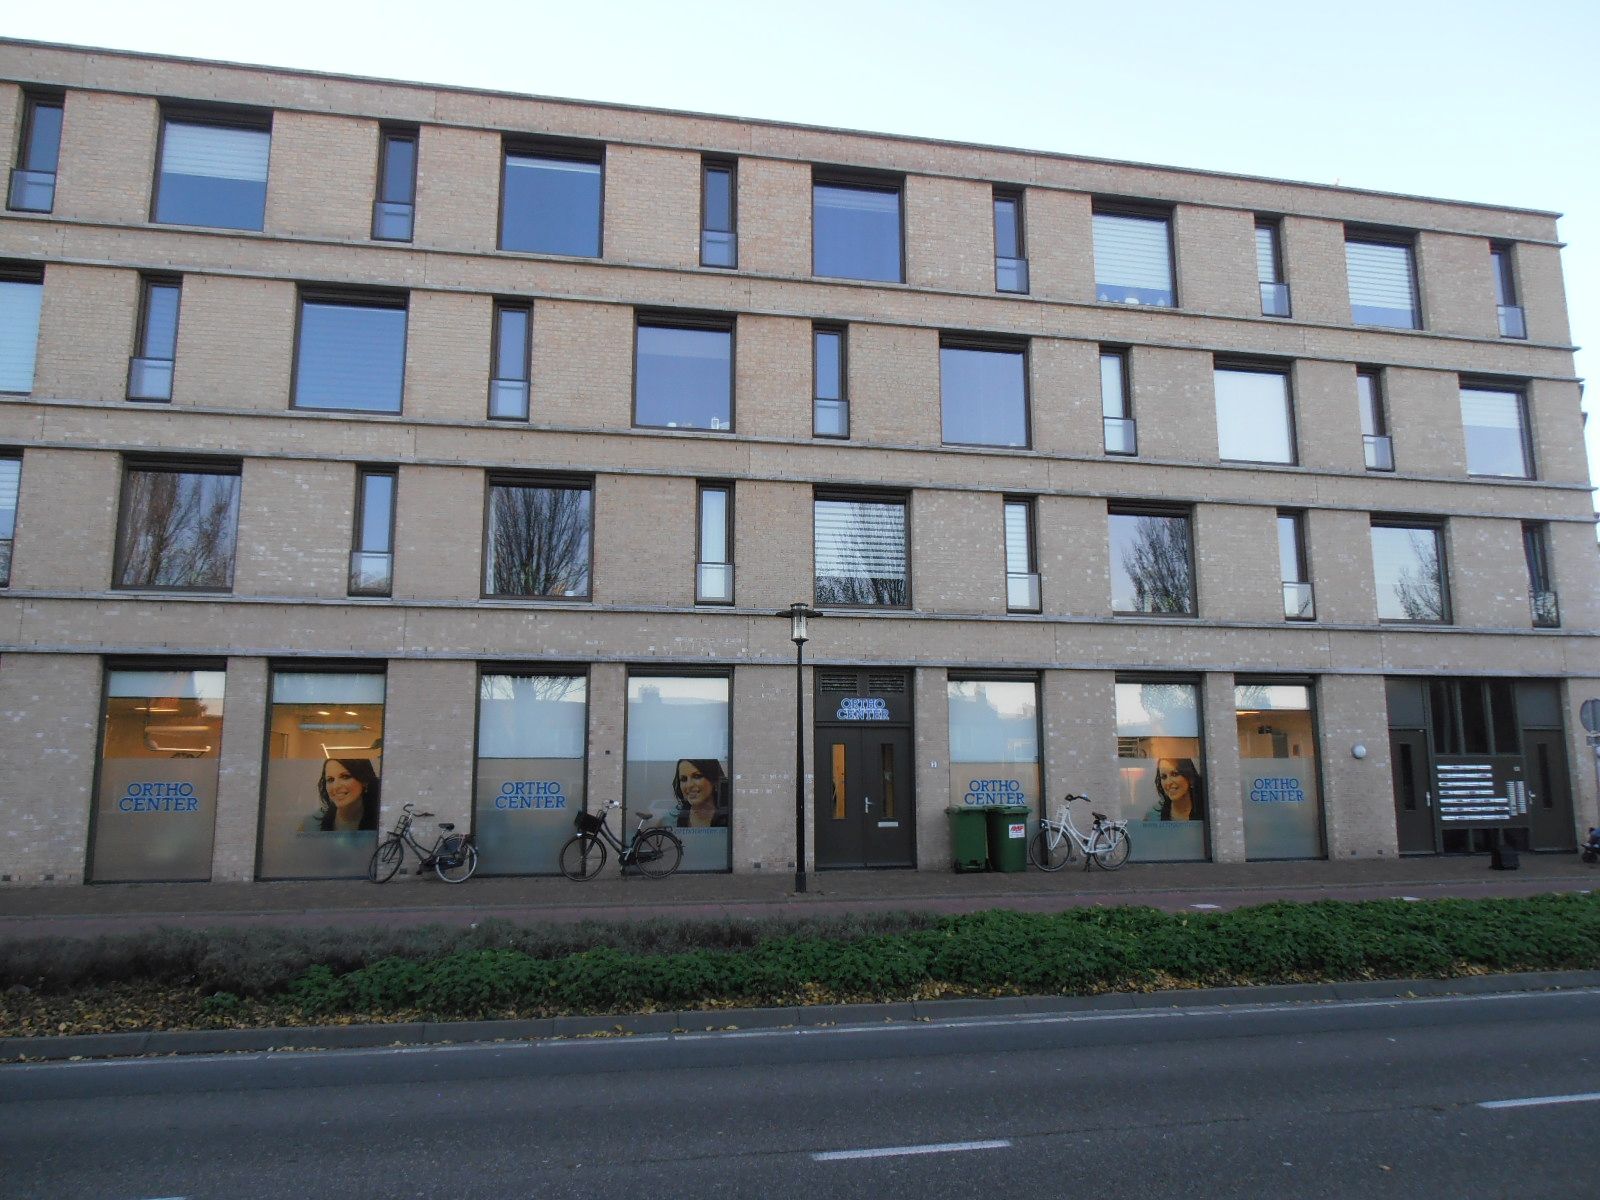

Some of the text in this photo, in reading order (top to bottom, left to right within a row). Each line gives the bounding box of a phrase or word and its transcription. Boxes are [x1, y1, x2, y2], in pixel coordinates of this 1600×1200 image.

[841, 698, 886, 709] ORTHO
[837, 708, 889, 720] CENTER
[128, 782, 194, 796] ORTHO
[501, 781, 561, 795] ORTHO
[969, 779, 1020, 792] ORTHO
[1254, 778, 1299, 789] ORTHO
[495, 795, 566, 809] CENTER
[964, 792, 1025, 805] CENTER
[1250, 790, 1304, 801] CENTER
[120, 797, 198, 811] CENTER
